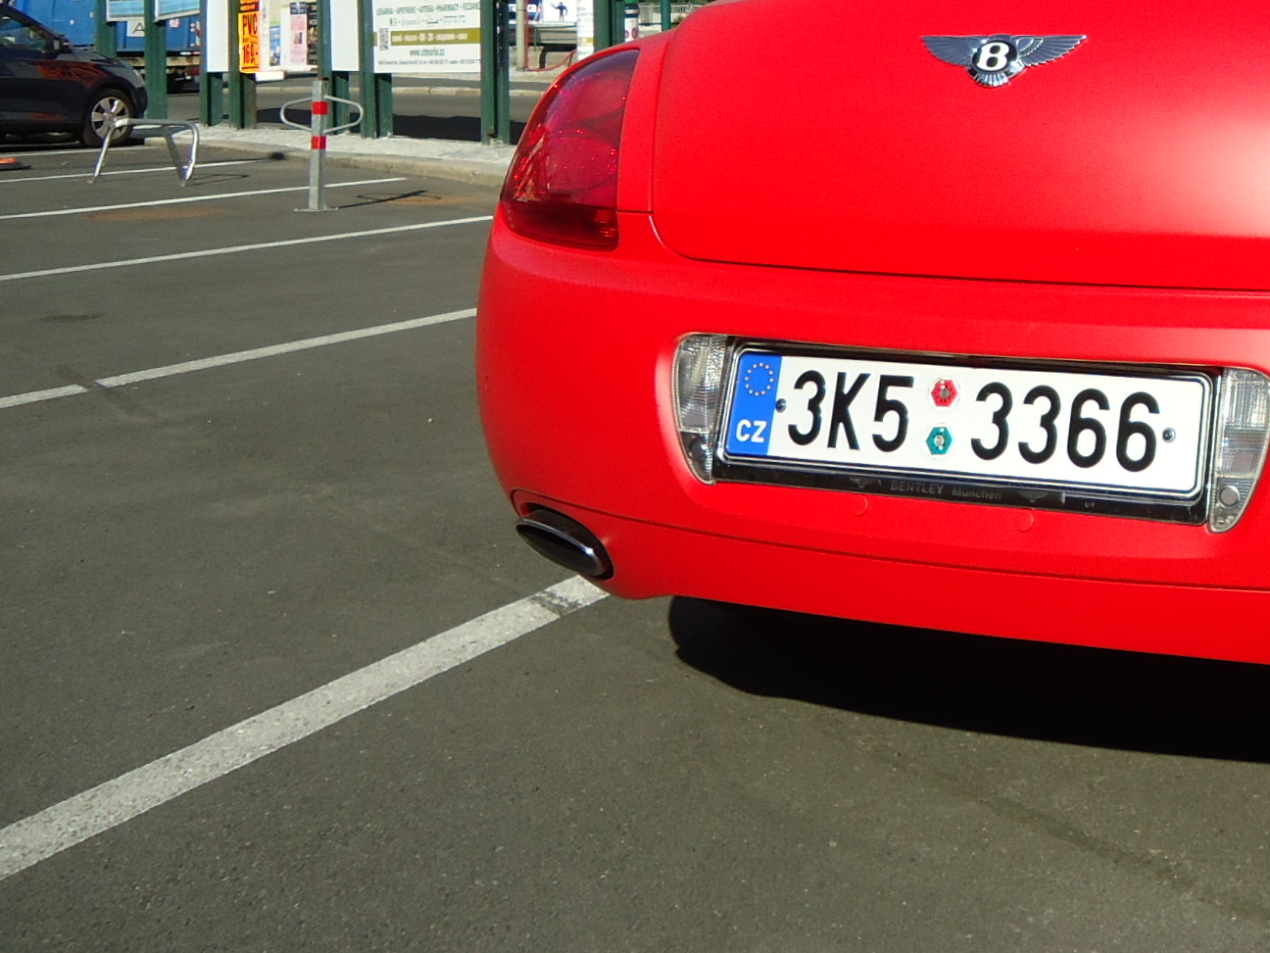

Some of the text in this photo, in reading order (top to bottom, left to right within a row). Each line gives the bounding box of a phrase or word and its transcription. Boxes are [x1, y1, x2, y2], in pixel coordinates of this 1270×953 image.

[242, 13, 258, 35] PVC
[736, 419, 767, 444] CZ
[788, 370, 1160, 472] 3K5 3366
[890, 480, 944, 496] BENTLEY
